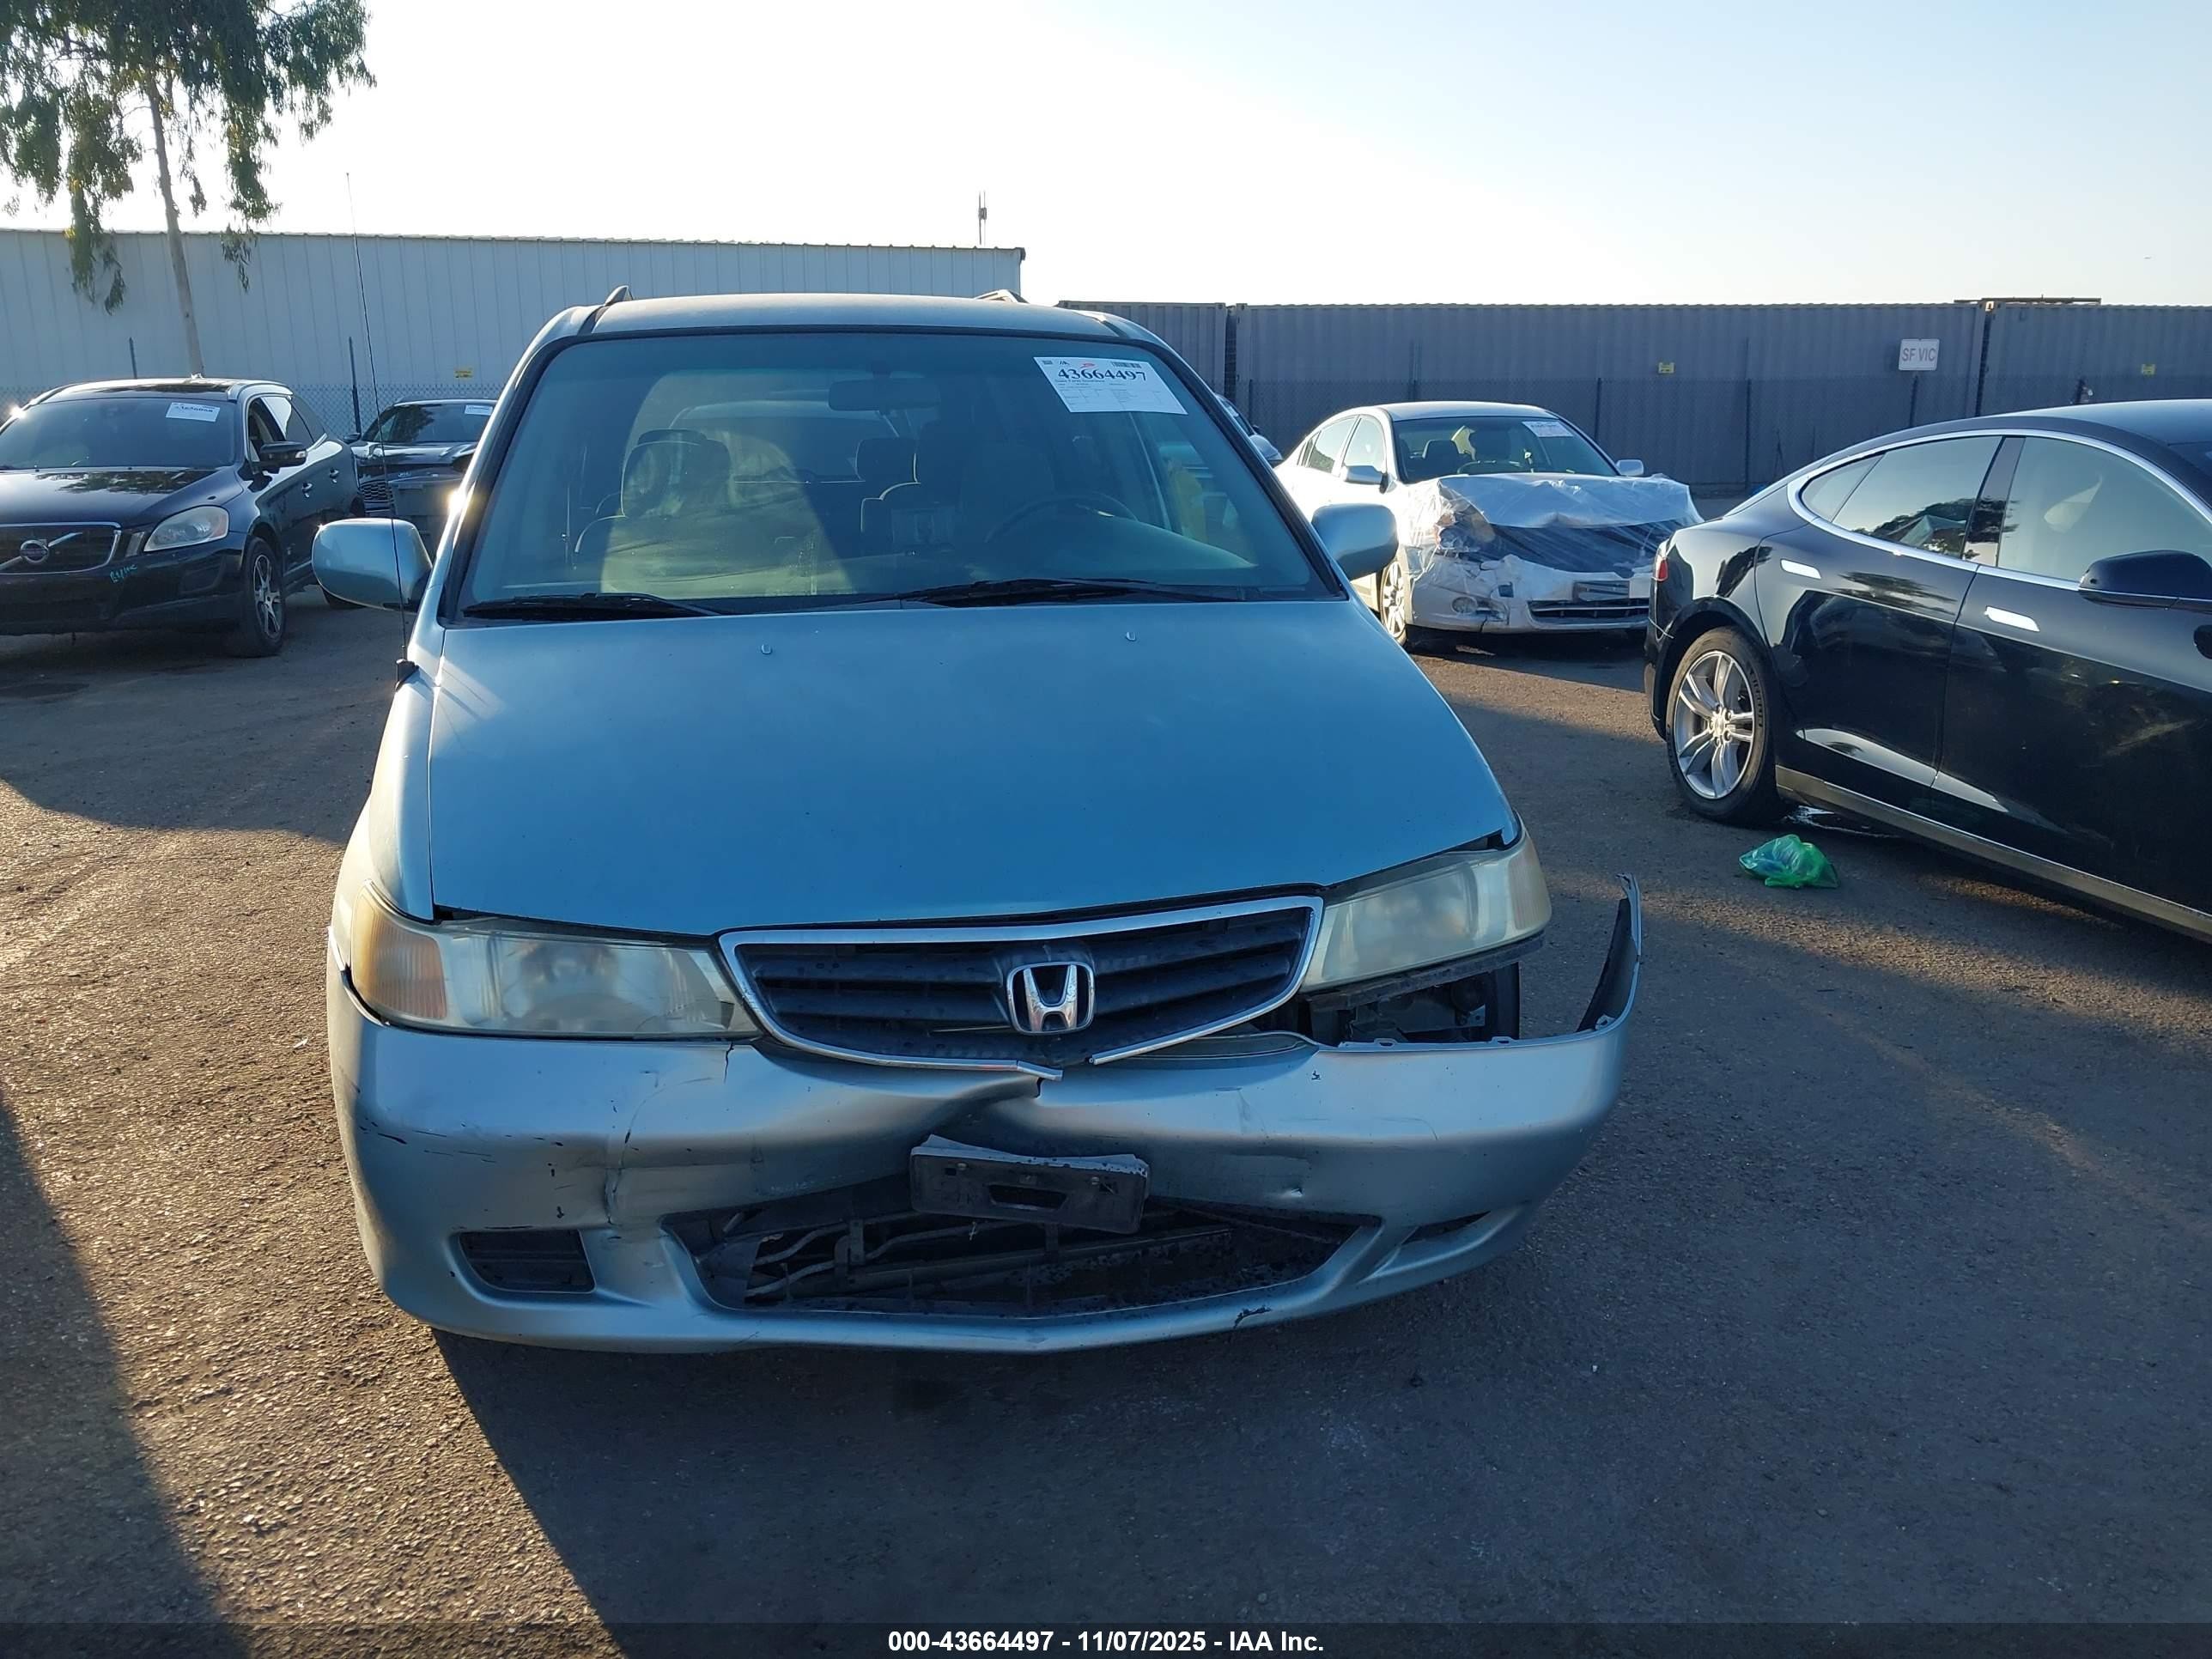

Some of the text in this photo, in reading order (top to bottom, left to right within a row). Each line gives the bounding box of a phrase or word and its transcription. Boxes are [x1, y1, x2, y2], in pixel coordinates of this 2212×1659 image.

[1901, 347, 1936, 362] SF VIC
[1057, 368, 1147, 381] 43664497
